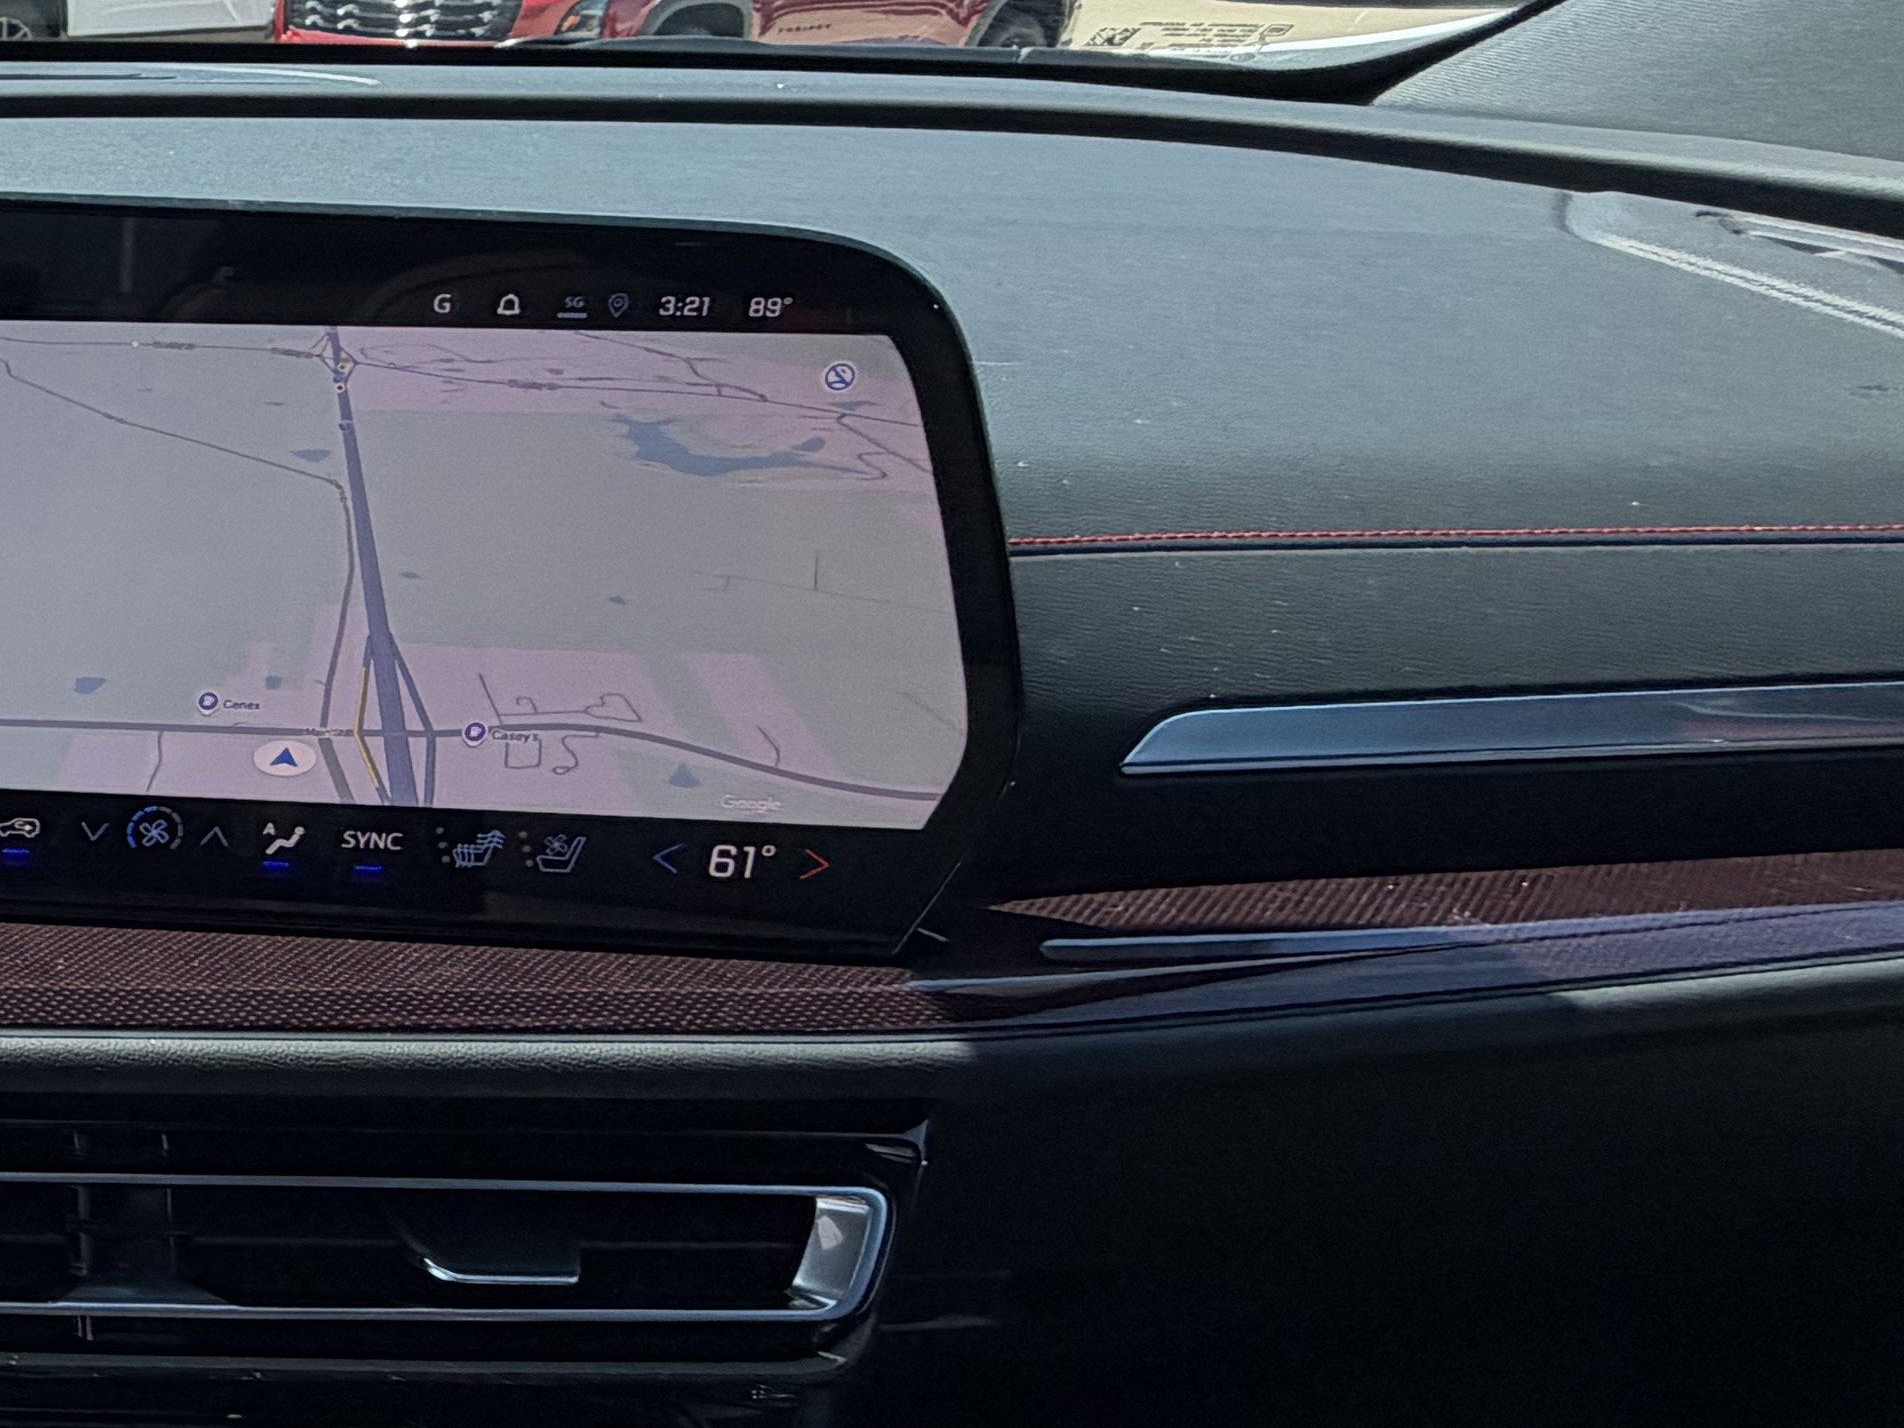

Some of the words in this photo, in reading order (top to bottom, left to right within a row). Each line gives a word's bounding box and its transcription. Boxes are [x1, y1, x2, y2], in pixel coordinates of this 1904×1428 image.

[658, 295, 711, 317] 3:21
[748, 296, 794, 318] 89°
[341, 829, 403, 852] SYNC
[707, 843, 778, 880] 61°
